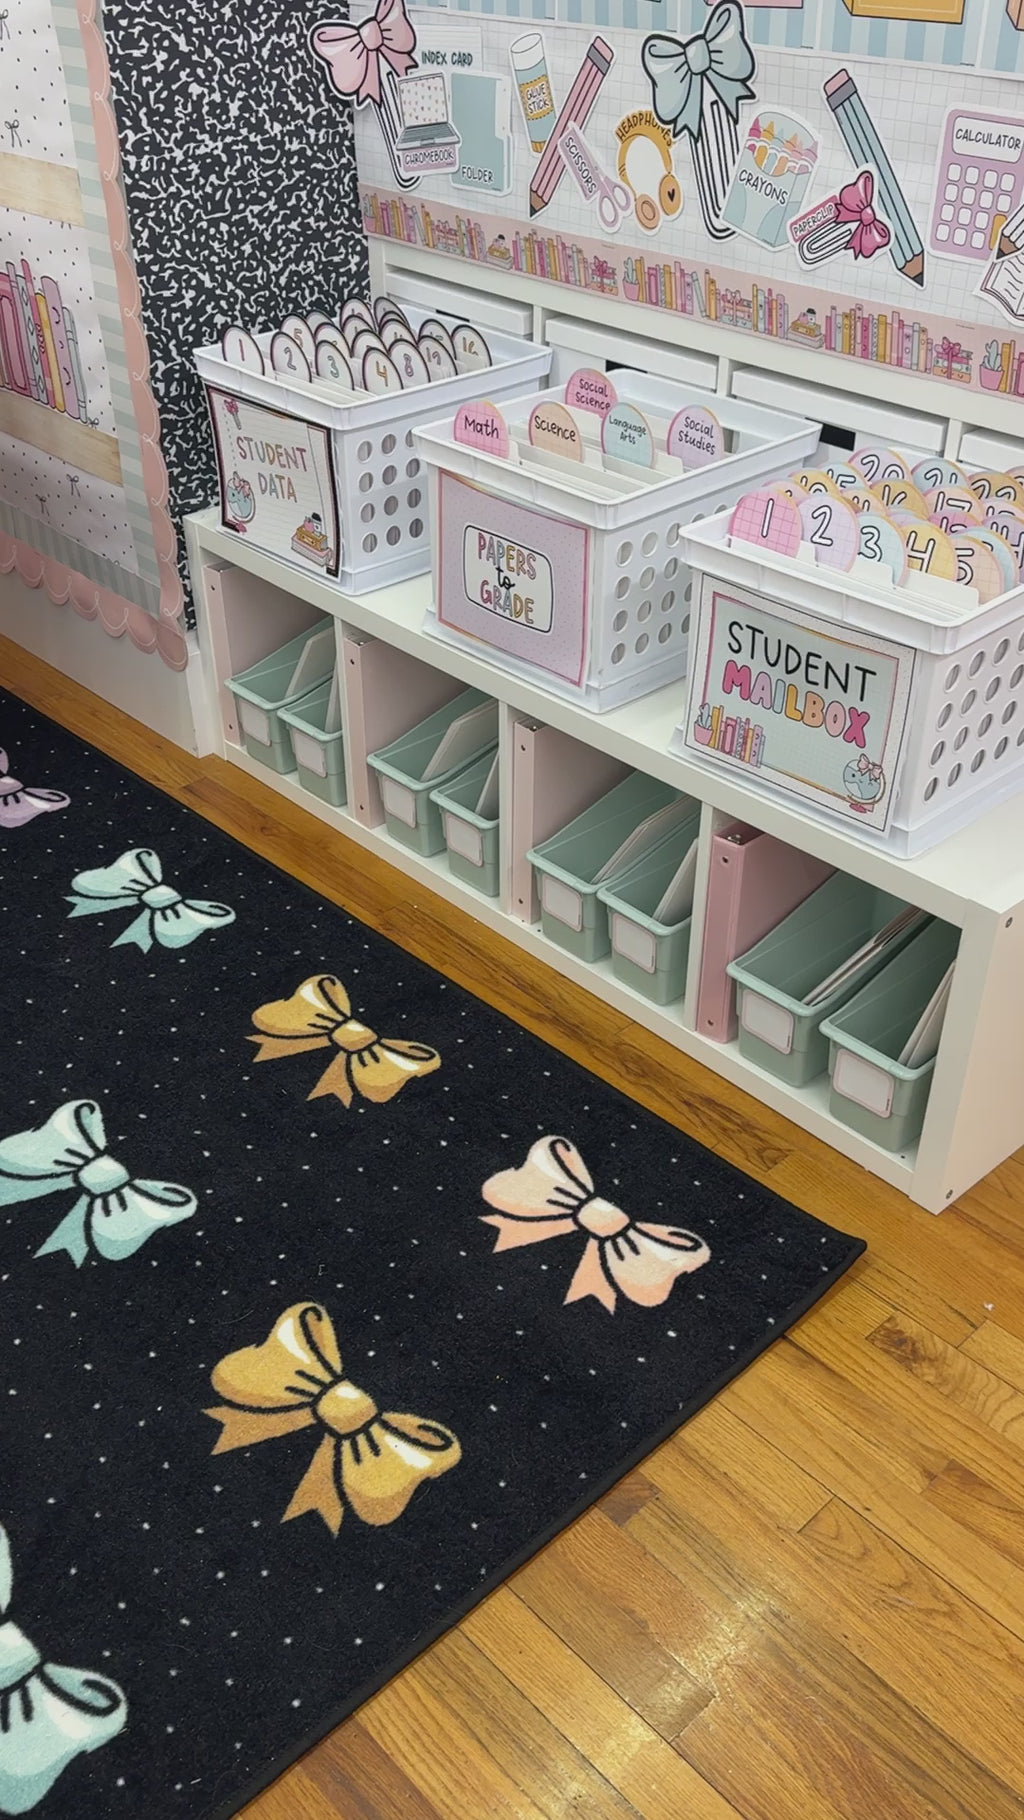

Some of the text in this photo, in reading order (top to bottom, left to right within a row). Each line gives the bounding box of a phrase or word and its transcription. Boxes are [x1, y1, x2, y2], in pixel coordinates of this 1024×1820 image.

[421, 50, 473, 66] INDEX CARD
[526, 83, 546, 100] GLUE
[528, 99, 549, 113] STICK
[955, 128, 1021, 150] CALCULATOR
[405, 149, 454, 165] CHROMEBOOK
[565, 137, 597, 193] SCISSORS
[461, 167, 494, 183] FOLDER
[739, 169, 788, 205] CRAYONS
[793, 204, 834, 237] PAPERCLIP
[238, 338, 245, 362] 1
[284, 346, 297, 371] 2
[327, 355, 340, 378] 3
[376, 360, 388, 387] 4
[403, 353, 414, 378] 8
[579, 378, 608, 398] Social
[575, 391, 612, 411] Science
[464, 414, 499, 439] Math
[534, 415, 576, 442] Science
[609, 415, 647, 438] Language
[619, 431, 636, 445] Arts
[684, 416, 714, 439] Social
[236, 436, 307, 472] STUDENT
[678, 430, 716, 456] Studies
[258, 472, 298, 503] DATA
[761, 498, 774, 538] 1
[811, 505, 833, 546] 2
[478, 532, 537, 580] PAPERS
[858, 525, 882, 562] 3
[906, 530, 936, 573] 4
[495, 566, 516, 590] to
[955, 547, 975, 586] 5
[480, 580, 535, 625] GRADE
[728, 620, 877, 702] STUDENT
[722, 659, 870, 749] MAILBOX
